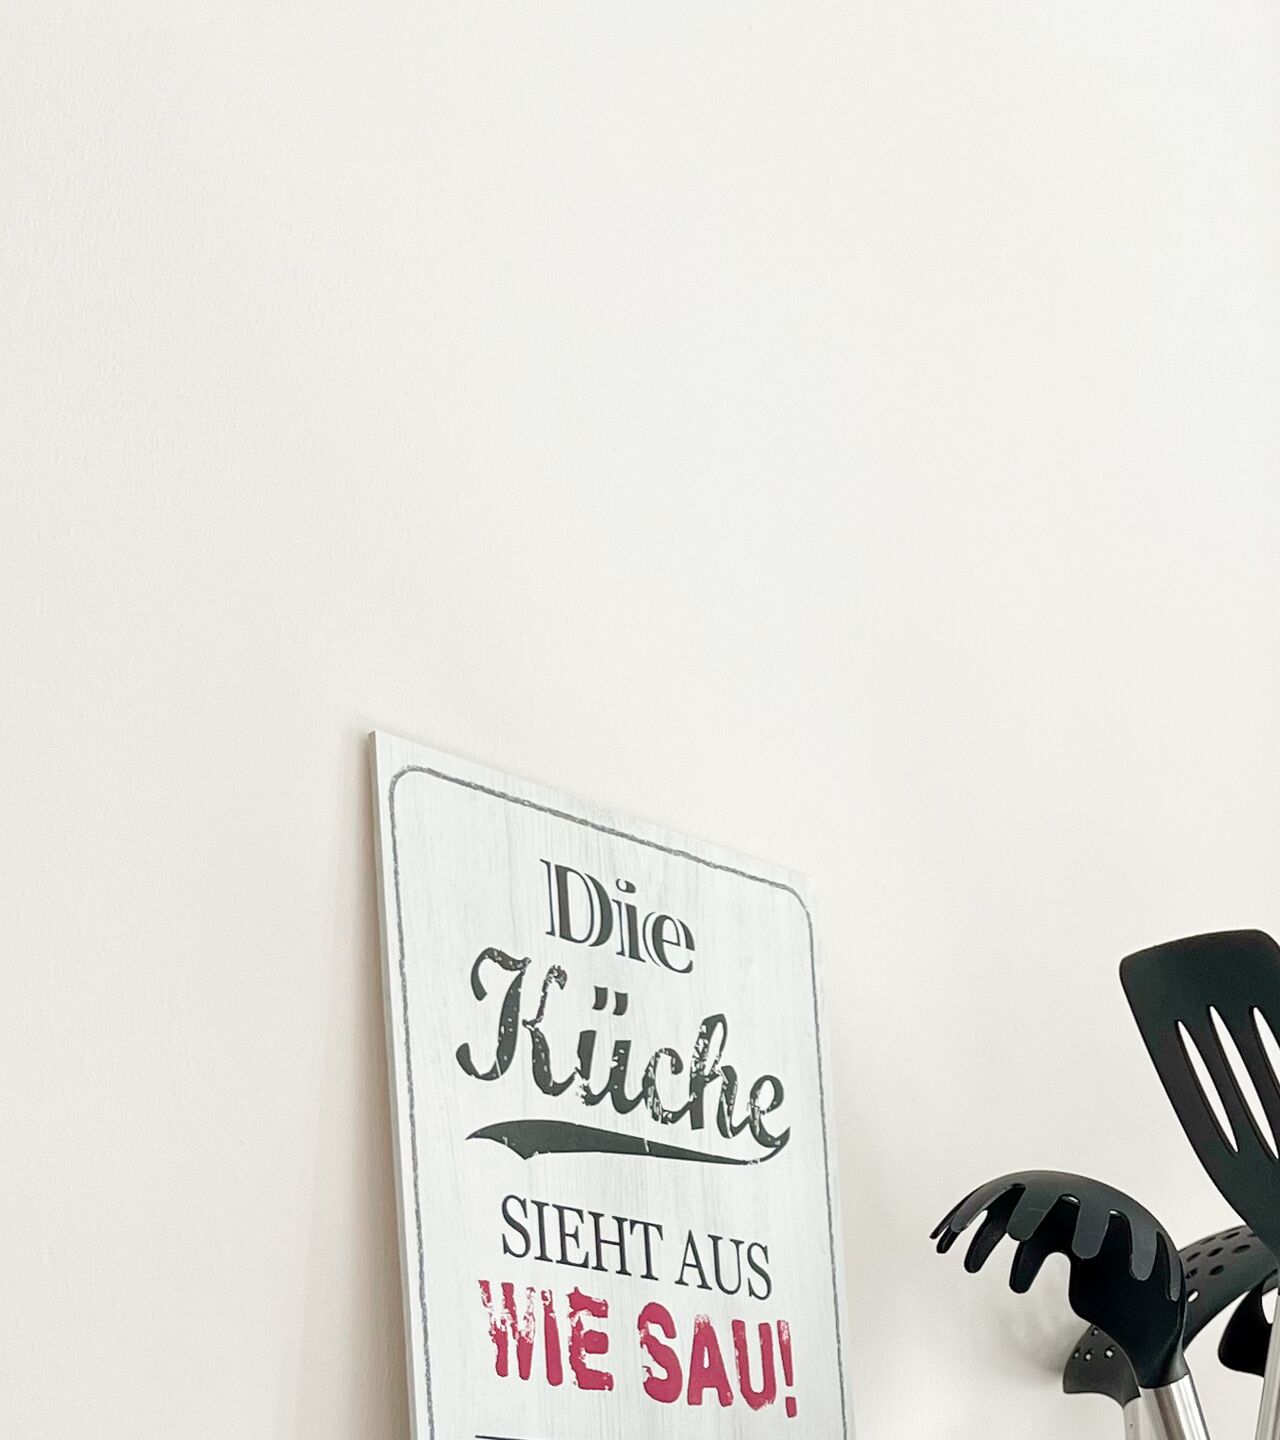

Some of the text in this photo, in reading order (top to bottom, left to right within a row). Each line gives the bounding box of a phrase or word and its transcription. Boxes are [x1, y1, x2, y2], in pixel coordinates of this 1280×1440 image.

[539, 858, 695, 974] Die
[455, 947, 791, 1148] Küche
[501, 1194, 772, 1301] SIEHT AUS
[478, 1279, 798, 1419] WIE SAU!
